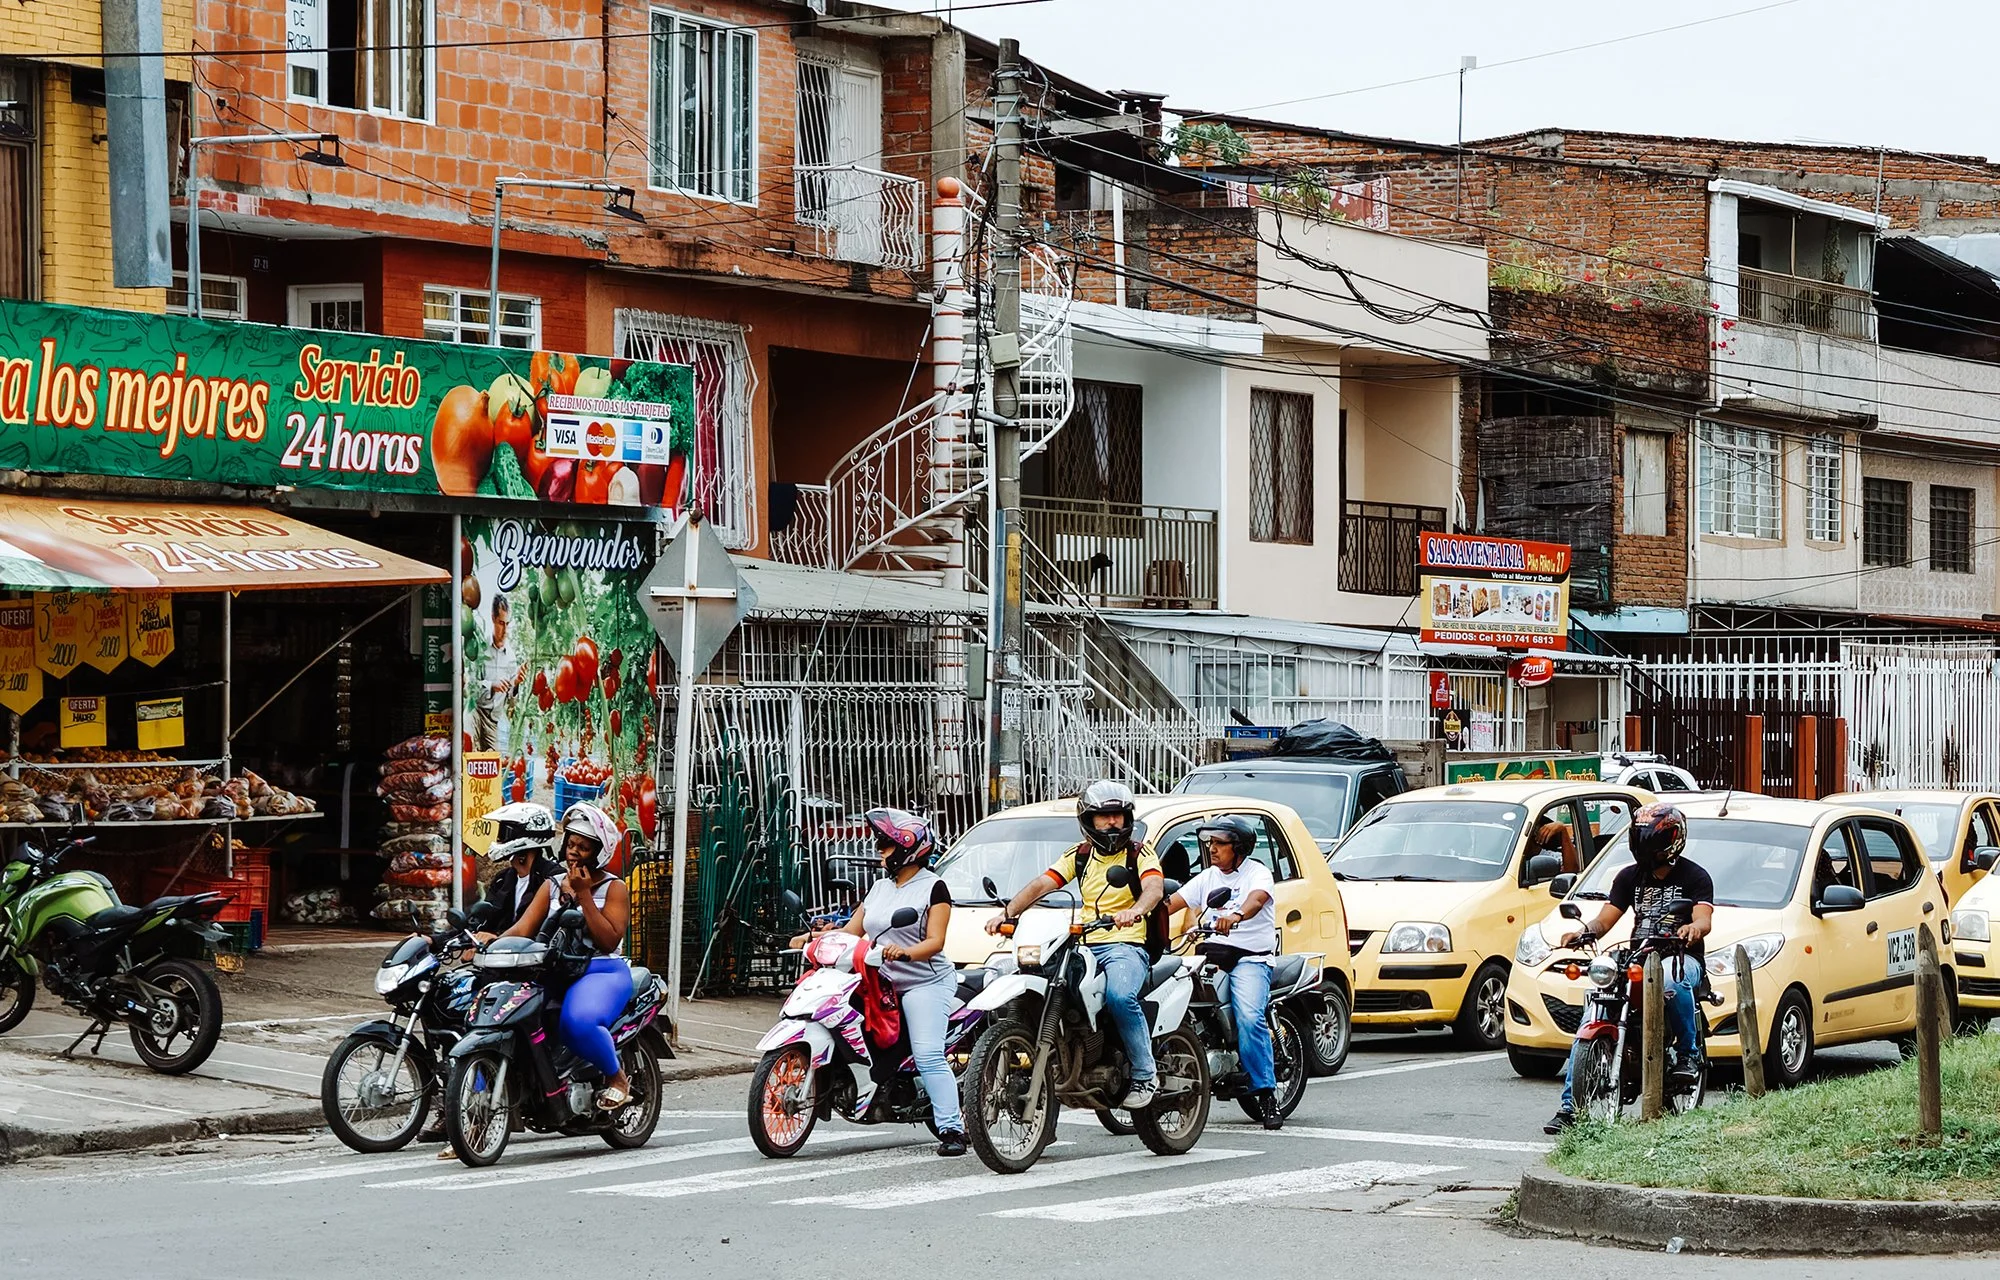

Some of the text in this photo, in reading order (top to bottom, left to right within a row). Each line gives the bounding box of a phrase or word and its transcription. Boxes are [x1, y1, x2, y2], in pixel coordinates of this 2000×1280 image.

[293, 10, 305, 27] DE
[287, 31, 313, 54] ROPA
[294, 344, 421, 409] Servicio
[0, 337, 270, 459] a los mejores
[549, 396, 670, 418] RECIBIMOS TODAS LAS TARJETAS
[280, 412, 423, 476] 24 horas
[554, 429, 577, 445] VISA
[57, 505, 290, 538] Servicio
[119, 541, 384, 574] 24 horas
[495, 517, 645, 593] Bienvenidos
[1427, 537, 1526, 570] SALSAMENTARIA
[1555, 551, 1565, 574] 27
[1491, 572, 1508, 580] Venta
[1515, 574, 1532, 582] Mayor
[1434, 631, 1554, 645] PEDIDOS: Cel 310 741 6813
[428, 635, 440, 673] kikes
[69, 699, 96, 710] OFERTA
[467, 761, 498, 775] OFERTA
[1662, 885, 1674, 907] YORK
[1673, 885, 1683, 899] ITY
